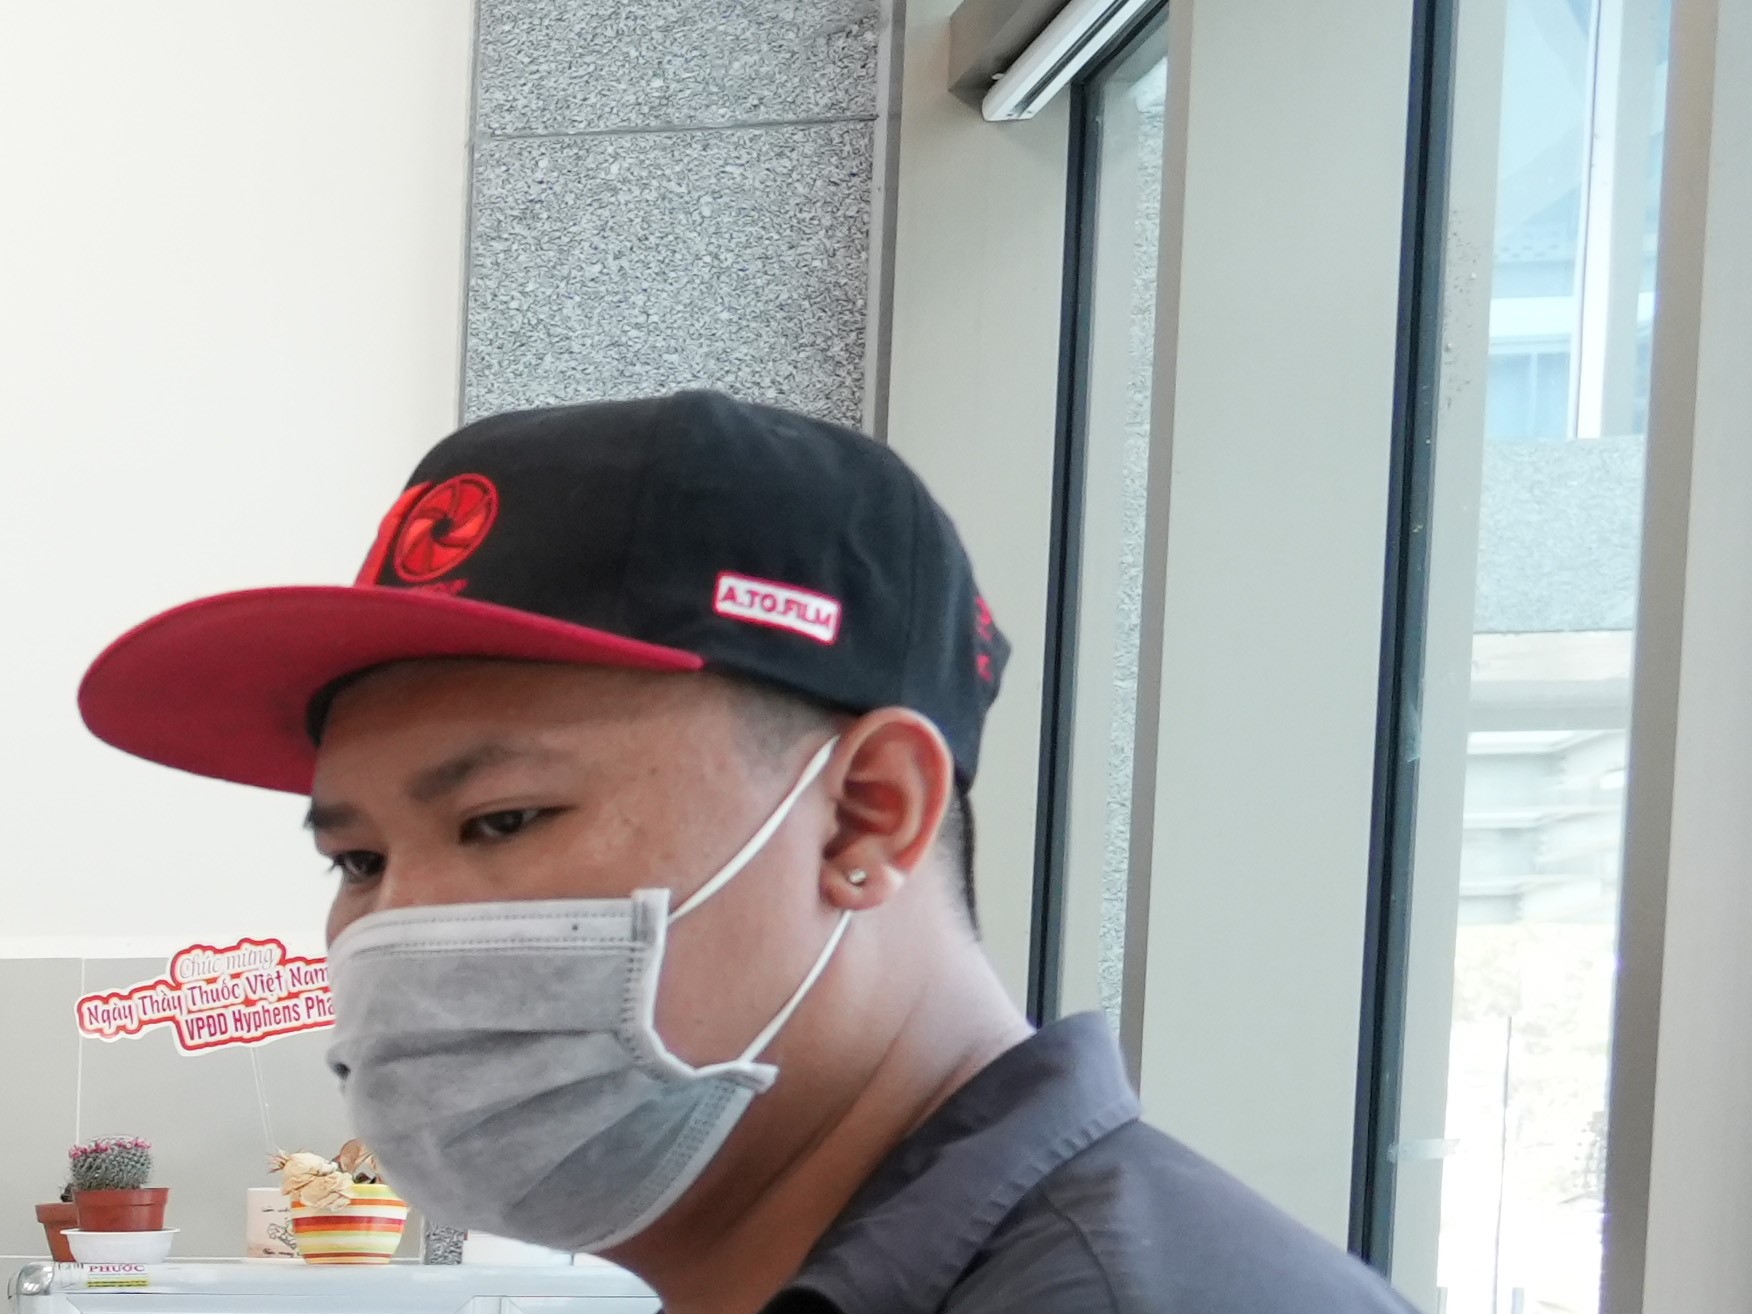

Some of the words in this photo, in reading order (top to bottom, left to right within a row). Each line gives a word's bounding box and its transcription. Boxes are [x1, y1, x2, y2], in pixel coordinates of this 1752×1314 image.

[179, 953, 221, 979] Chúc
[225, 946, 275, 971] mừng
[87, 1000, 135, 1031] Ngày
[138, 988, 183, 1018] Thầy
[187, 978, 240, 1009] Thuốc
[245, 970, 284, 997] Việt
[185, 1013, 229, 1041] VPĐD
[233, 1000, 302, 1034] Hyphens
